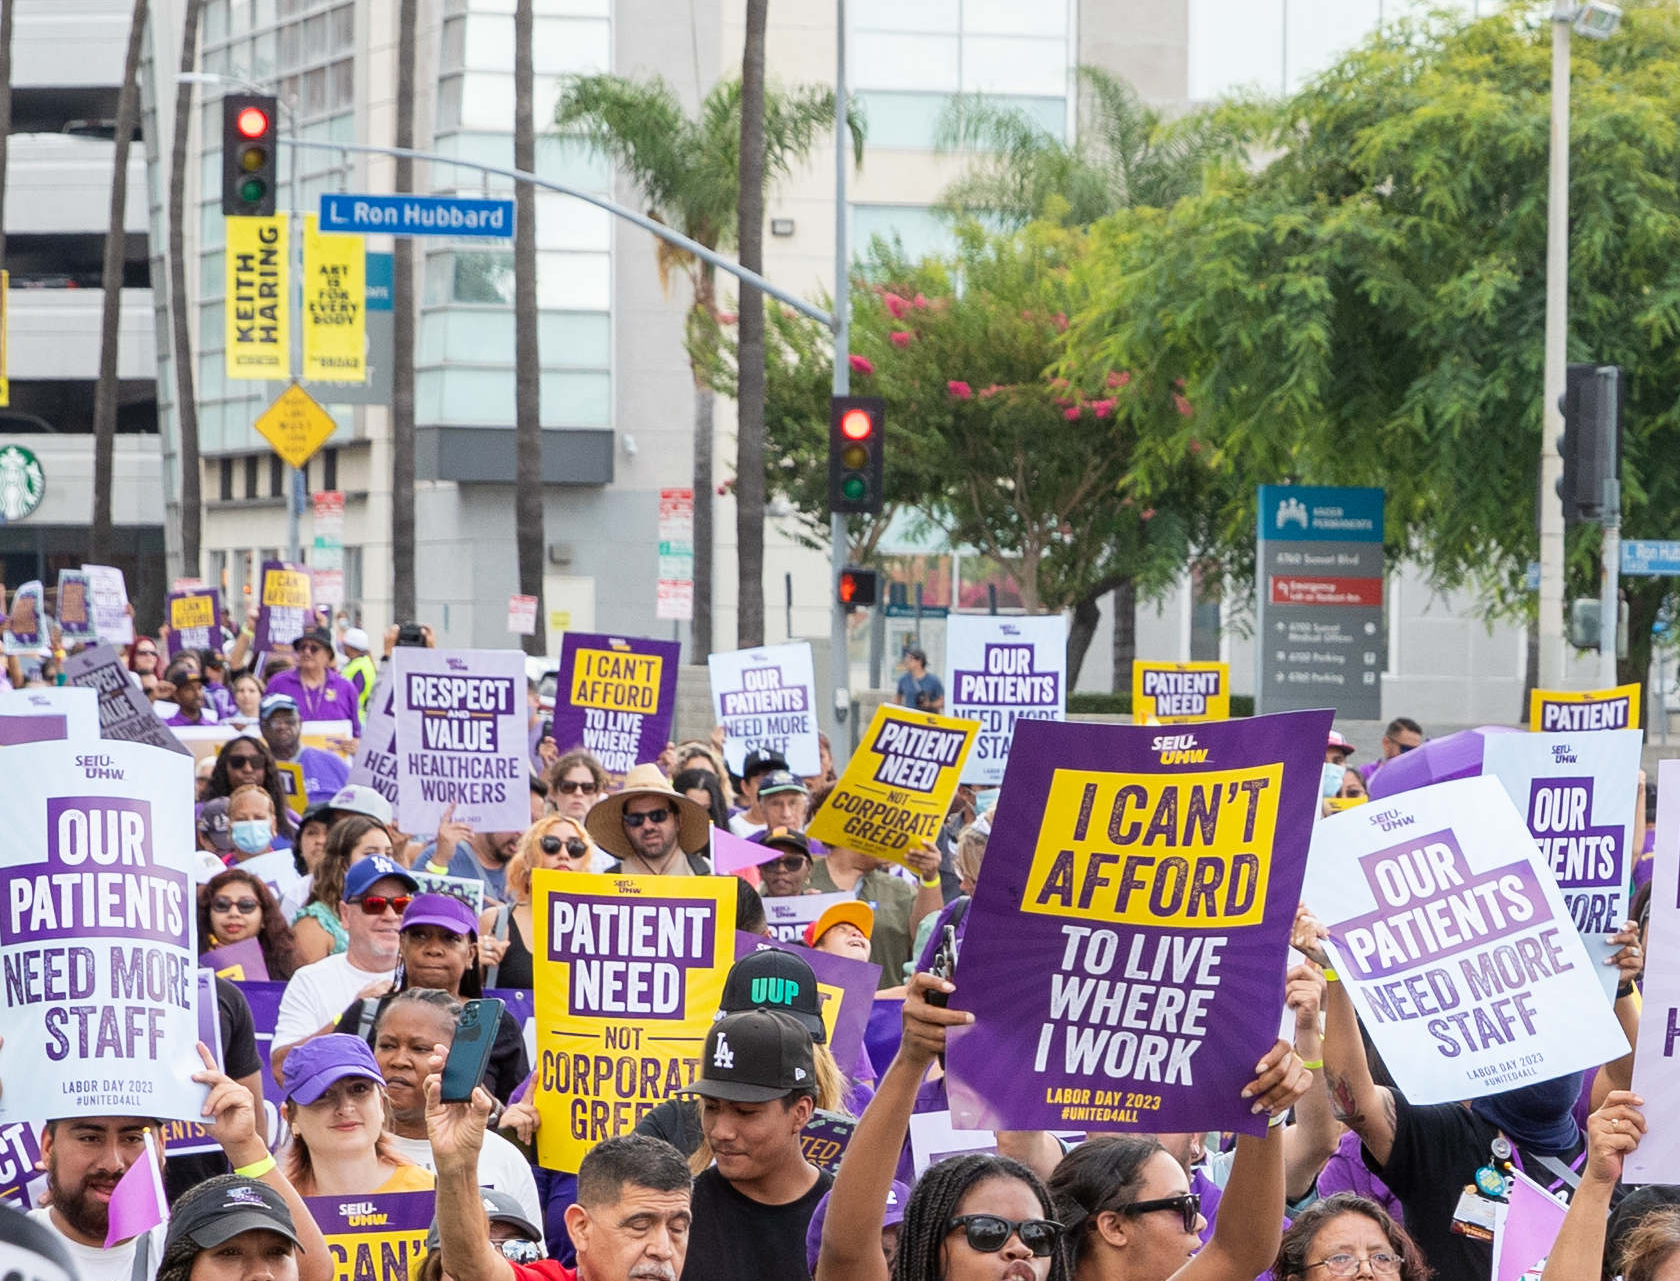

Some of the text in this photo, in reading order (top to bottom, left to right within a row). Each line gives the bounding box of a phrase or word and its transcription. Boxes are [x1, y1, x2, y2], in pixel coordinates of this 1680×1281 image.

[354, 203, 503, 228] Ron Hubbard
[237, 253, 254, 343] KEITH
[259, 227, 278, 343] HARING
[310, 303, 357, 313] EVERY
[313, 315, 354, 325] BODY
[988, 647, 1032, 674] OUR
[411, 675, 511, 711] RESPECT
[745, 669, 780, 690] OUR
[959, 673, 1056, 703] PATIENTS
[721, 687, 805, 714] PATIENTS
[424, 718, 496, 751] VALUE
[724, 717, 809, 736] NEED MORE
[876, 722, 964, 766] PATIENT
[1151, 736, 1197, 750] SEIU-
[407, 754, 519, 779] HEALTHCARE
[878, 755, 940, 790] NEED
[1161, 750, 1209, 764] UHW
[420, 781, 506, 804] WORKERS
[888, 790, 910, 803] NOT
[832, 790, 937, 835] CORPORATE
[1111, 778, 1270, 847] CAN'T
[57, 810, 143, 867] OUR
[844, 817, 910, 848] GREED
[1036, 850, 1259, 919] AFFORD
[1375, 842, 1465, 908] OUR
[9, 871, 182, 936] PATIENTS
[552, 900, 712, 957] PATIENT
[1348, 873, 1534, 975] PATIENTS
[1059, 925, 1228, 986] TO LIVE
[3, 946, 190, 1008] NEED MORE
[575, 964, 681, 1015] NEED
[751, 978, 799, 1004] UUP
[1361, 928, 1575, 1022] NEED MORE
[1050, 975, 1215, 1035] WHERE
[45, 1006, 166, 1062] STAFF
[604, 1027, 643, 1050] NOT
[1428, 994, 1540, 1060] STAFF
[713, 1031, 734, 1068] LA
[1062, 1028, 1201, 1087] WORK
[1046, 1087, 1162, 1111] LABOR DAY 2023
[1061, 1107, 1138, 1123] #UNITED4ALL
